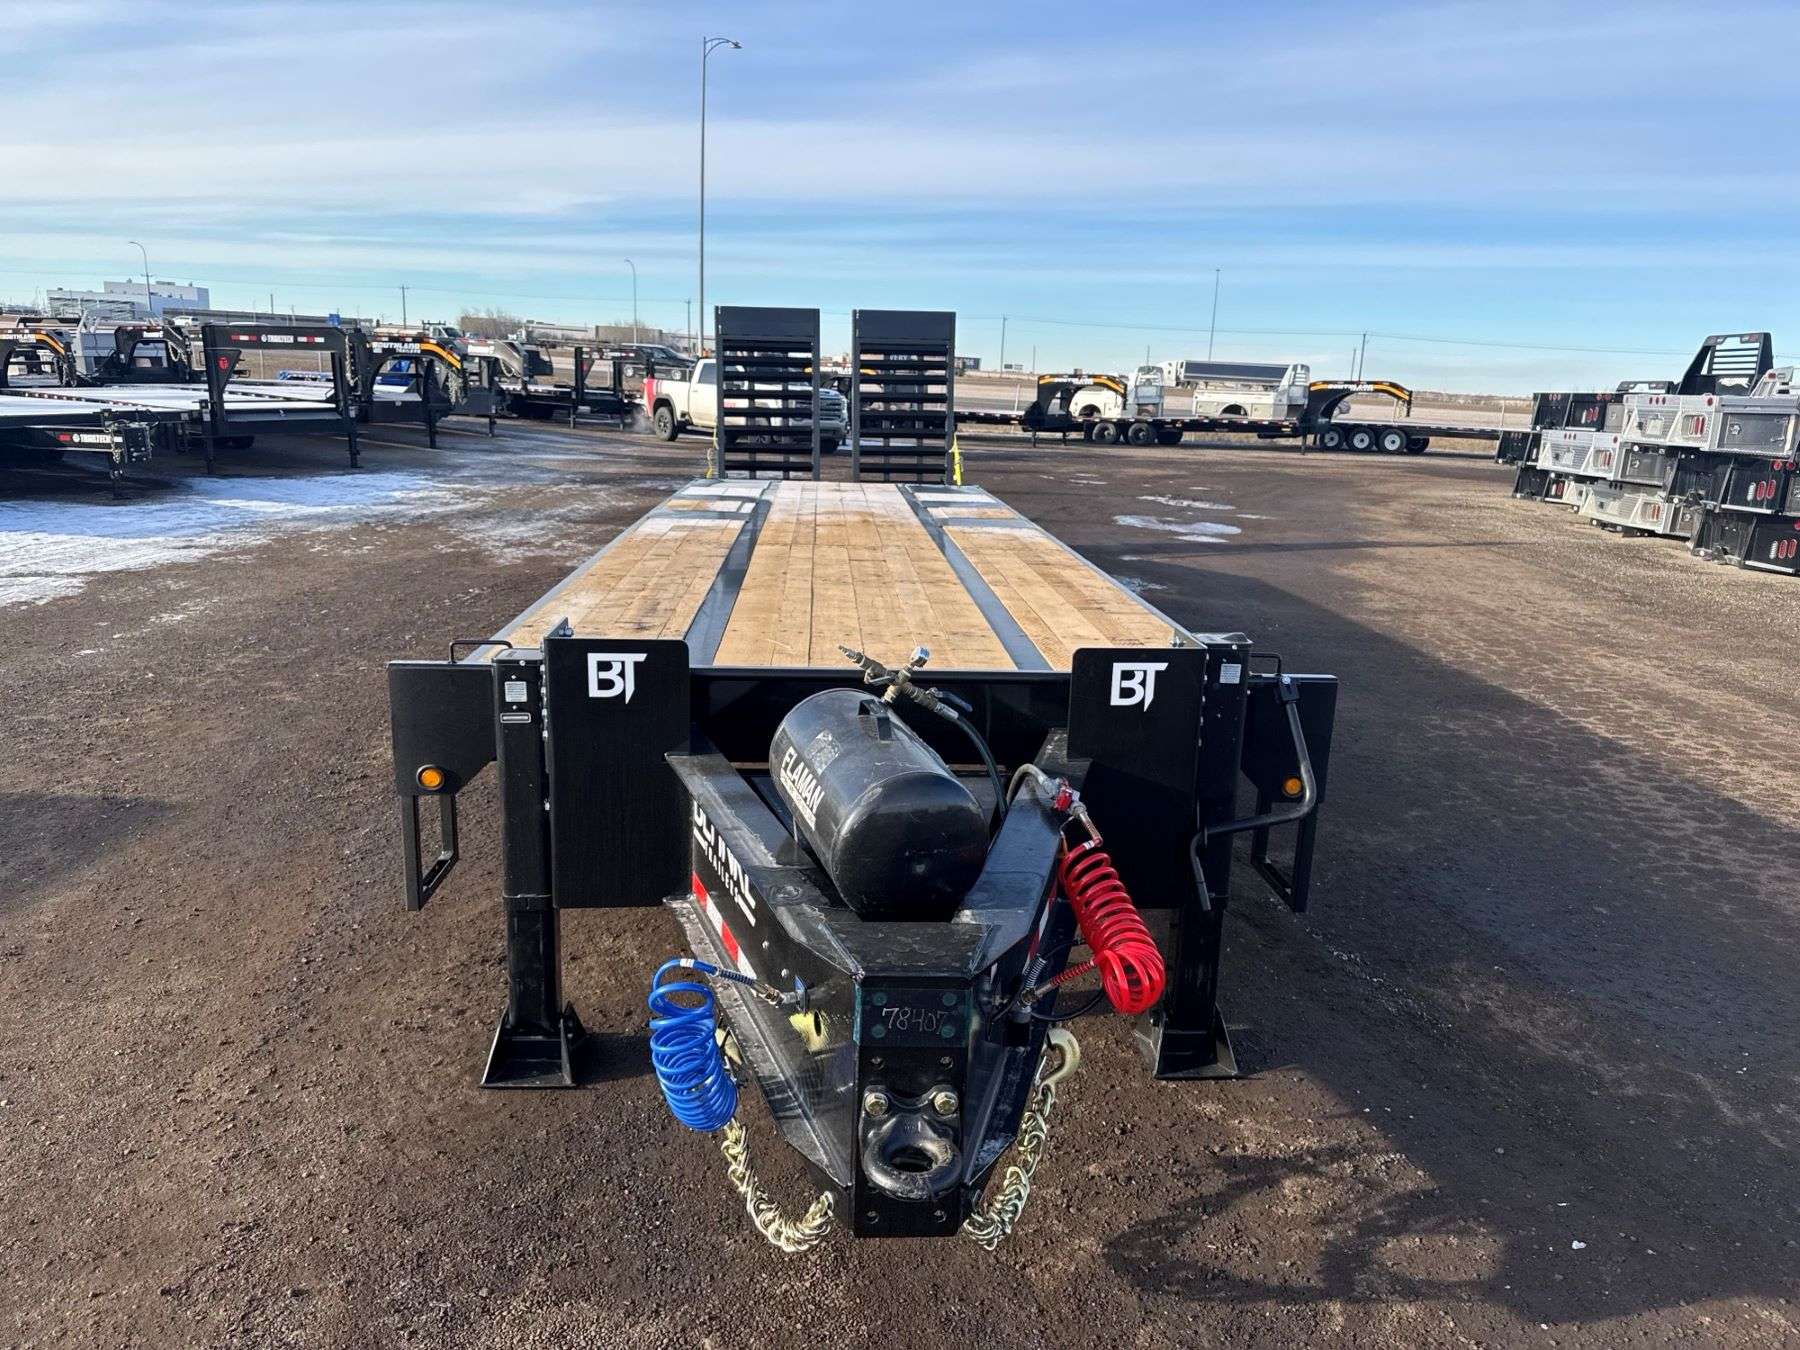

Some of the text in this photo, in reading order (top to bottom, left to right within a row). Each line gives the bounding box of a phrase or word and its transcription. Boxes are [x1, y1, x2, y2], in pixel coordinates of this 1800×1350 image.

[586, 652, 648, 705] BT
[1110, 662, 1169, 712] BT
[781, 746, 825, 815] FLAMAN
[882, 1006, 950, 1036] 78407
